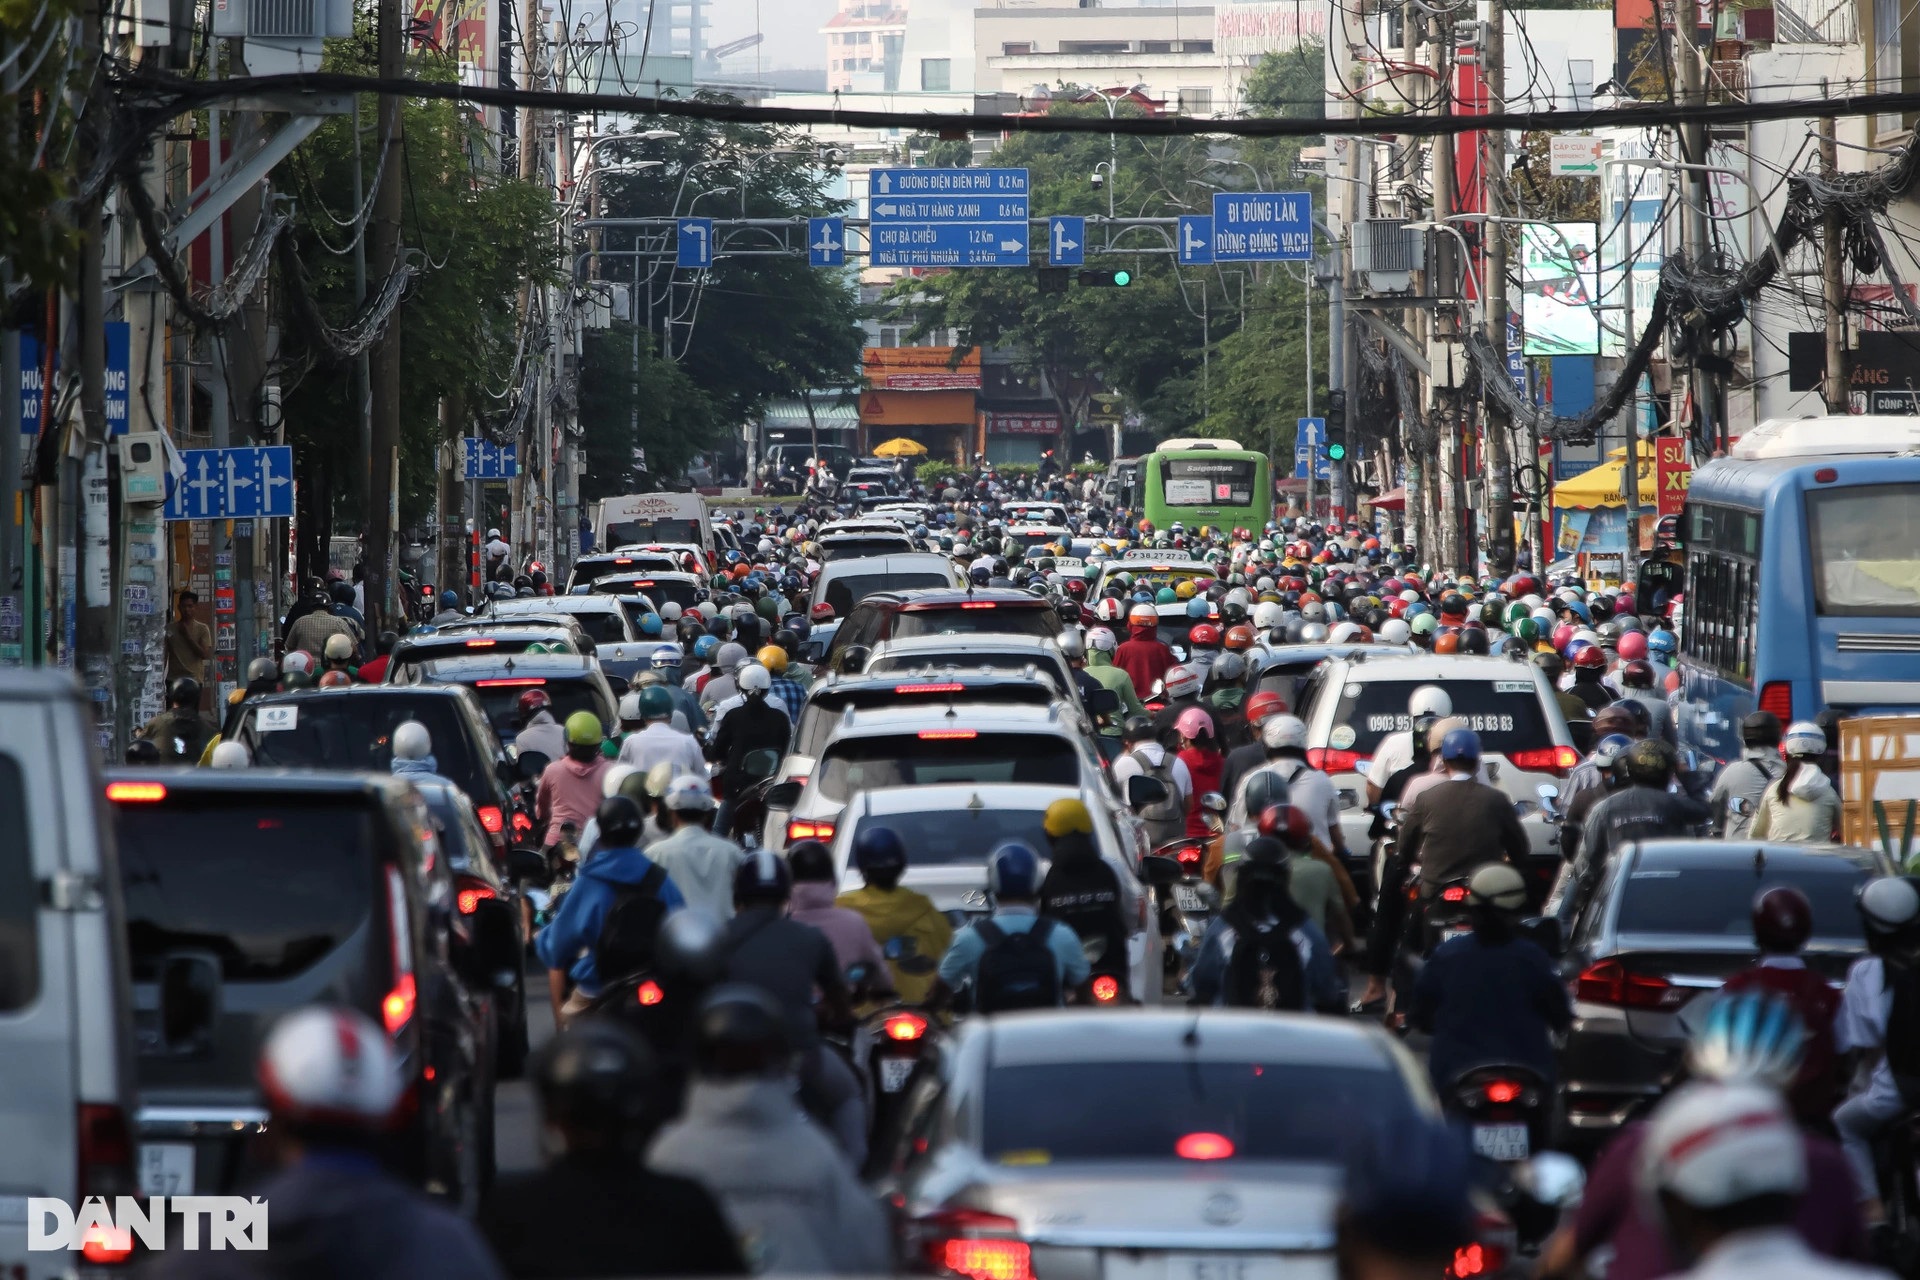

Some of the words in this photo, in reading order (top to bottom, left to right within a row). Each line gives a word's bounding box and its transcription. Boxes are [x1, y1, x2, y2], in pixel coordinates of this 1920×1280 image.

[900, 174, 928, 189] ĐƯỜNG
[931, 174, 950, 190] ĐIỆN
[953, 173, 972, 189] BIÊN
[974, 173, 991, 188] PHỦ
[1012, 176, 1024, 188] Km
[900, 203, 917, 217] NGÃ
[919, 204, 929, 217] TƯ
[932, 202, 954, 217] HÀNG
[957, 205, 980, 217] XANH
[1012, 205, 1024, 217] Km
[1228, 203, 1239, 222] ĐI
[1242, 197, 1272, 222] ĐÚNG
[1275, 197, 1299, 223] LÀN,
[880, 230, 898, 245] CHỢ
[900, 228, 910, 243] BÀ
[981, 231, 994, 243] Km
[1217, 229, 1246, 253] DỪNG
[1250, 229, 1278, 253] ĐÚNG
[1282, 233, 1309, 255] VẠCH
[880, 250, 897, 263] NGÃ
[899, 250, 909, 262] TƯ
[912, 248, 928, 263] PHÚ
[931, 249, 960, 265] NHUẬN
[1850, 364, 1889, 384] ÁNG
[23, 394, 38, 419] XÔ
[106, 394, 125, 420] ĨNH
[1664, 442, 1685, 463] SỬ
[622, 507, 680, 515] LUXURY
[1153, 552, 1164, 560] 27
[1370, 716, 1394, 732] 0903
[1397, 715, 1414, 731] 951
[1472, 716, 1484, 731] 16
[1486, 716, 1499, 731] 83
[1501, 716, 1514, 731] 83
